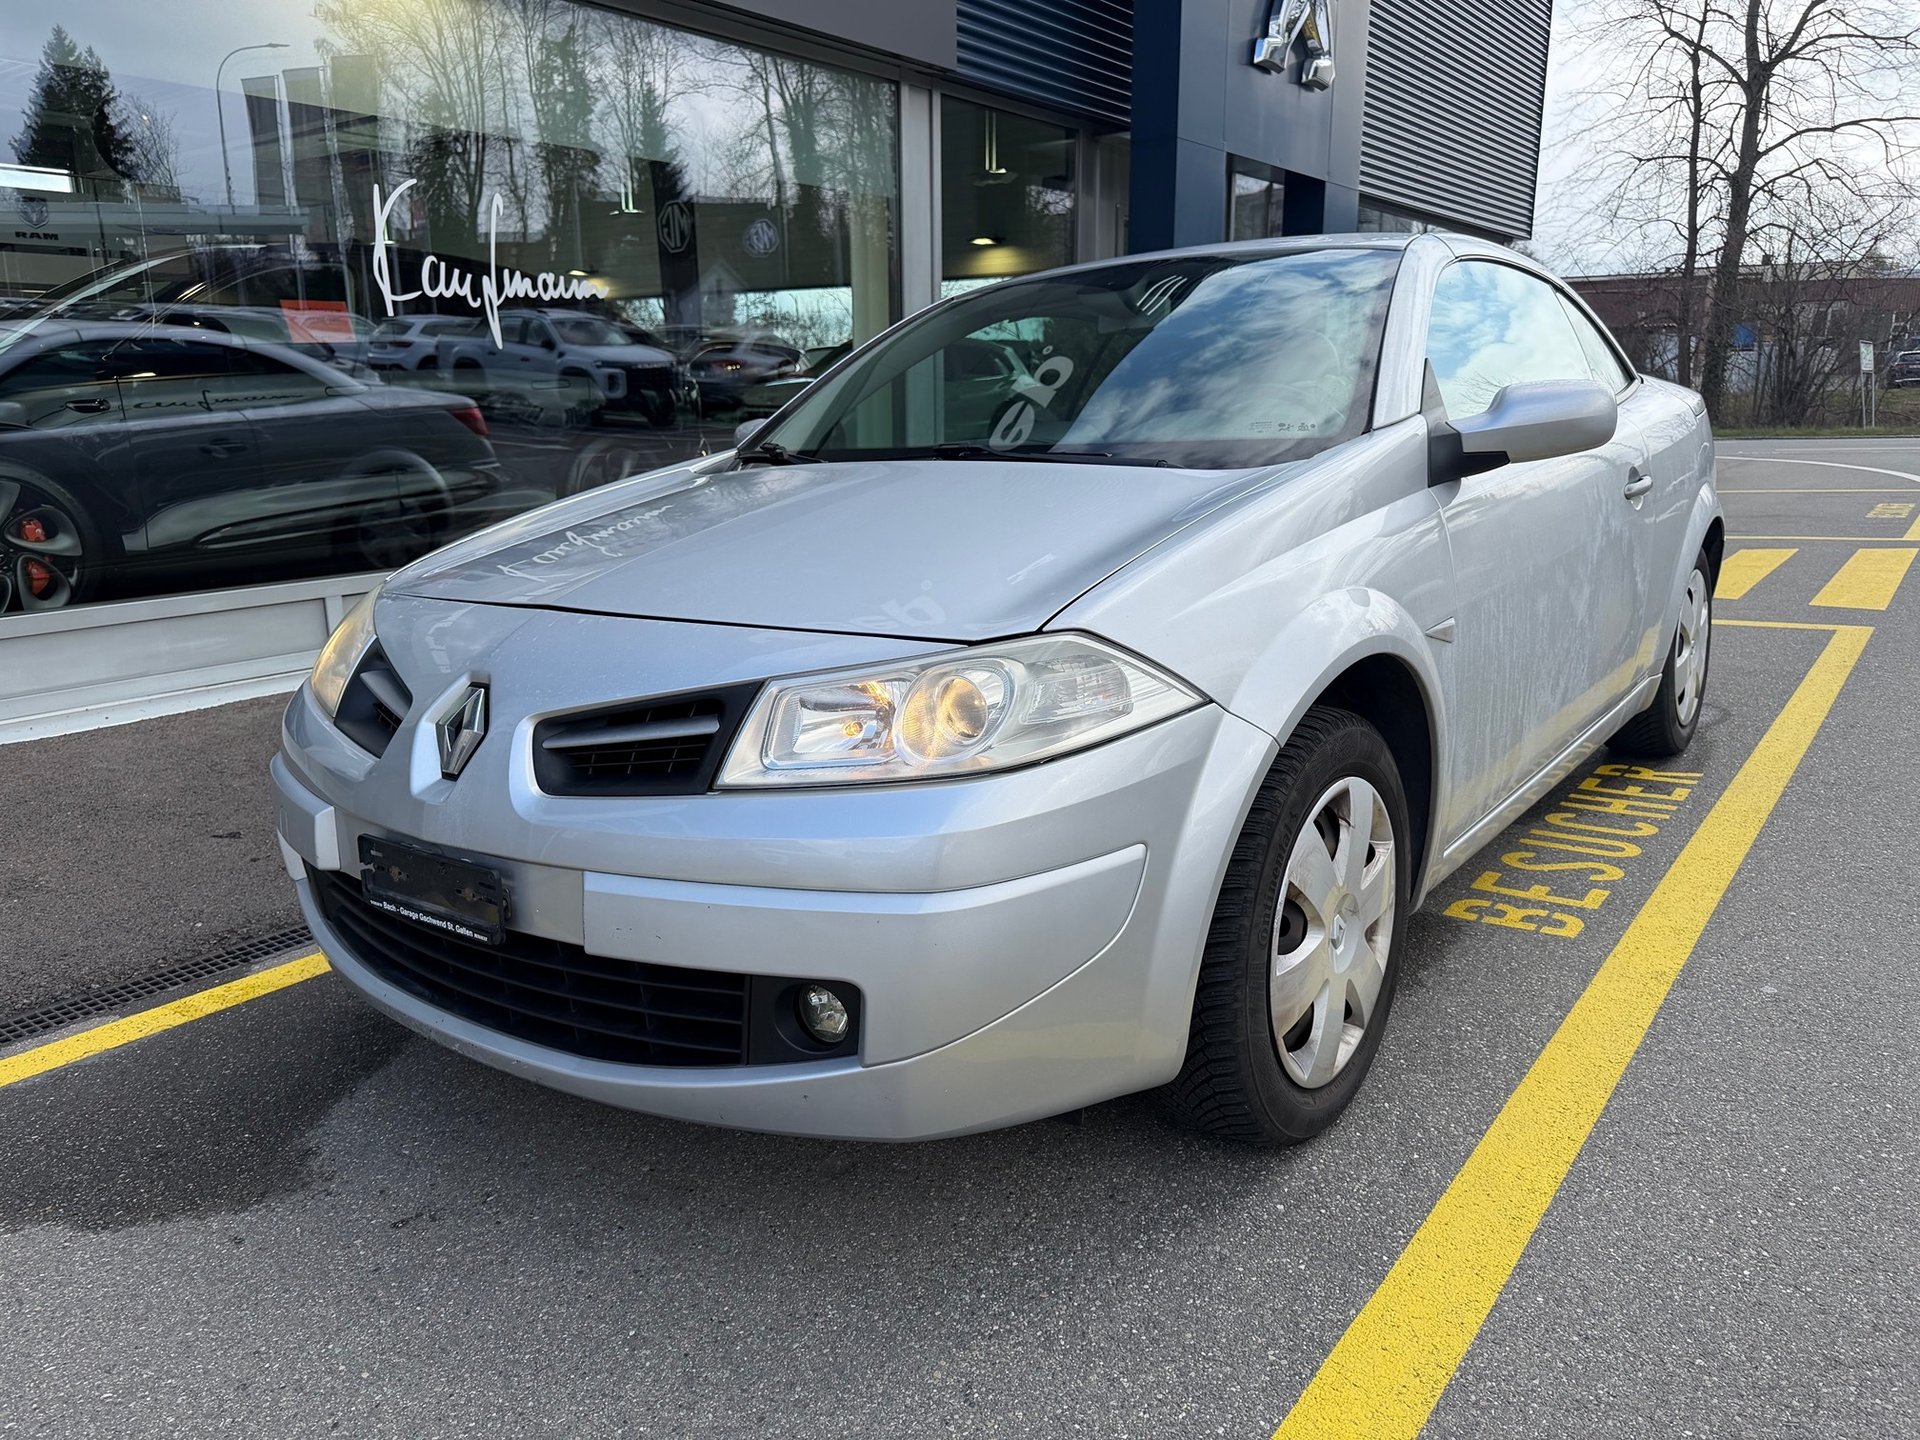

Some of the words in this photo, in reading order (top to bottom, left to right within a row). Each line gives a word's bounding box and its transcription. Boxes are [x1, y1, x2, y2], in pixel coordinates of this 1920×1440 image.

[15, 231, 59, 241] RAM
[373, 178, 609, 350] Kaufmann
[1442, 764, 1704, 939] BESUCHER
[400, 907, 419, 920] Garage
[455, 925, 473, 937] Gallen
